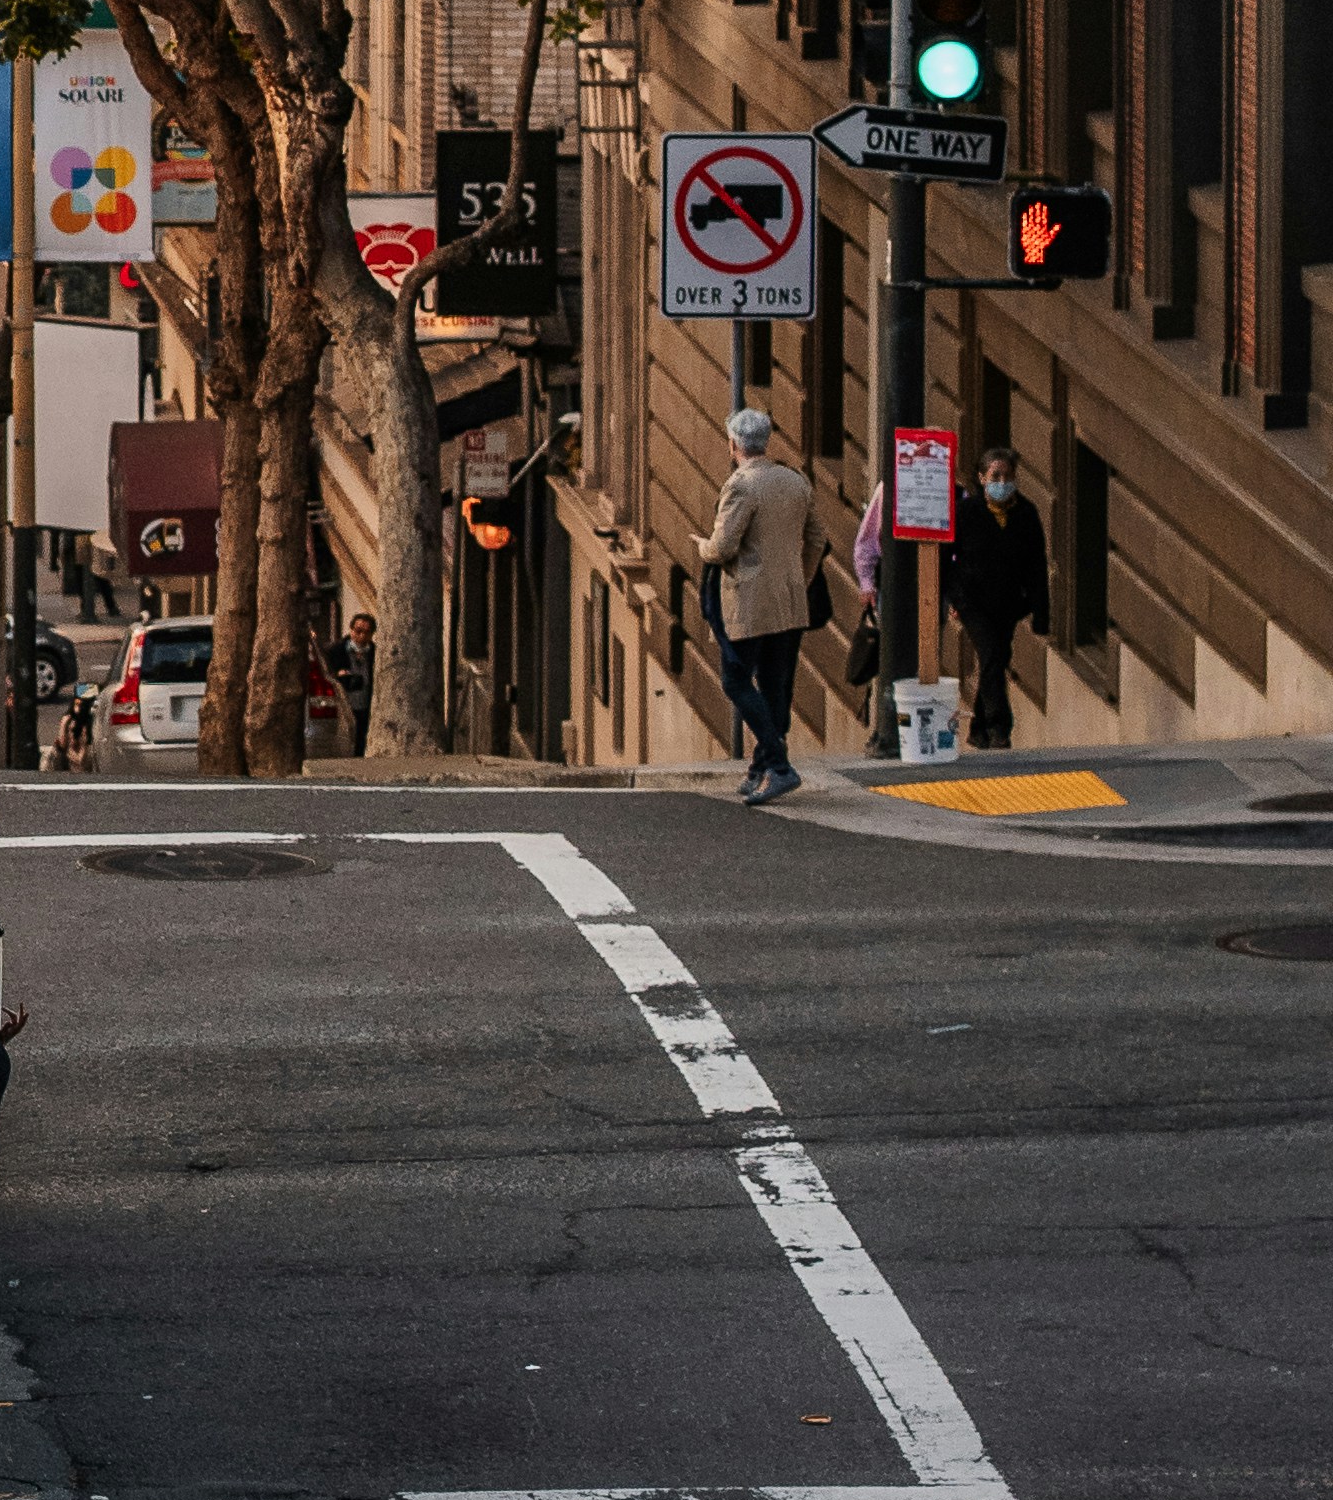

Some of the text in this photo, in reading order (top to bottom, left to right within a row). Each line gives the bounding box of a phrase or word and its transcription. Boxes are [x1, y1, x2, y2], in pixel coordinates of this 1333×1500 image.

[69, 75, 116, 87] UNION
[58, 88, 125, 106] SQUARE
[866, 126, 984, 160] ONE WAY
[675, 279, 803, 307] OVER 3 TONS
